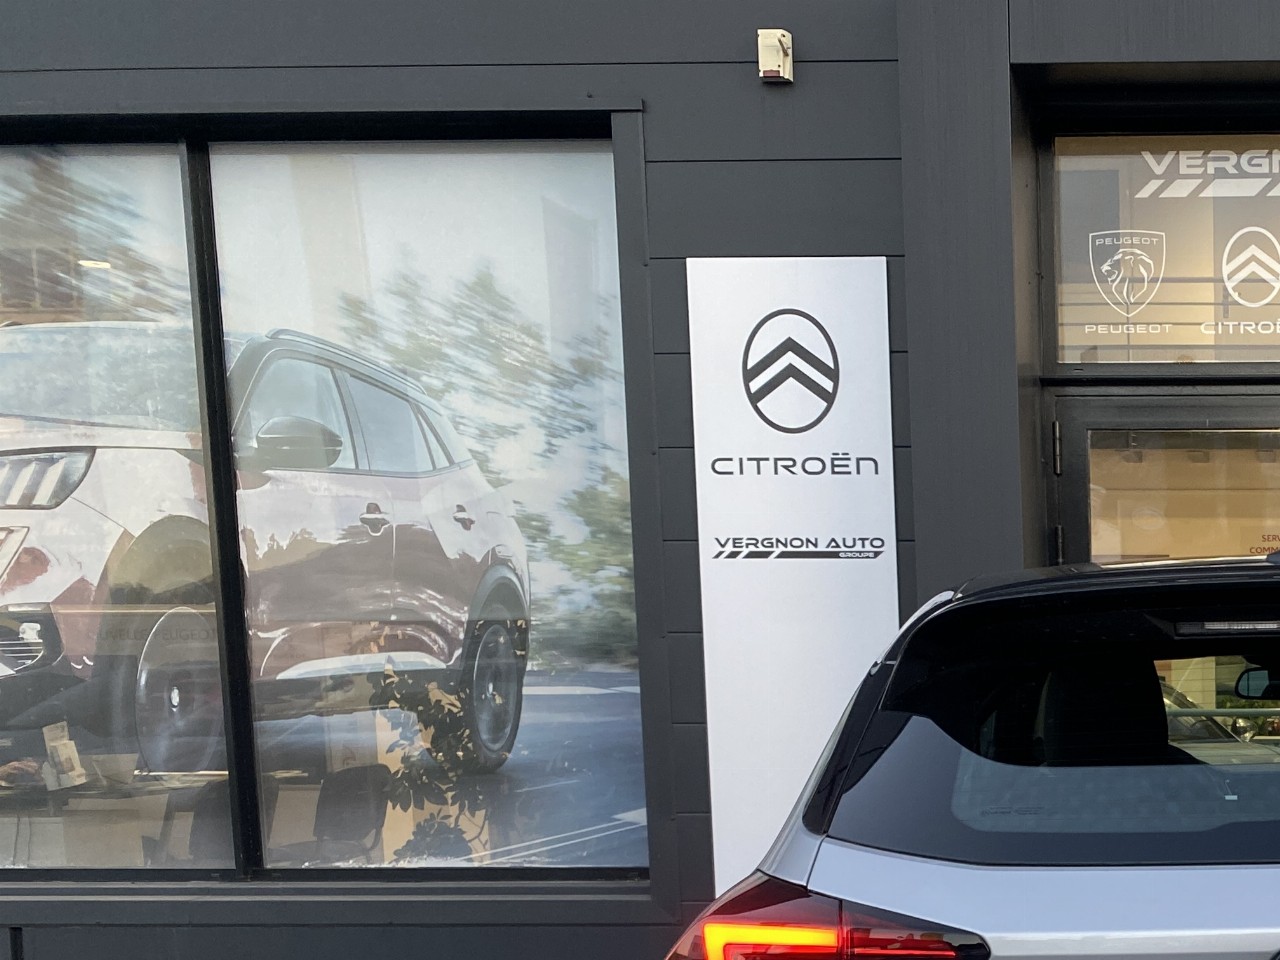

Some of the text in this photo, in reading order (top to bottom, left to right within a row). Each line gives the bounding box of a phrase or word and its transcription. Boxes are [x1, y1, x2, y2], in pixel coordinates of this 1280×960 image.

[1095, 236, 1160, 246] PEUGEOT
[1085, 323, 1173, 334] PEUGEOT
[714, 537, 885, 549] VERGNON AUTO
[838, 551, 875, 559] GROUPE
